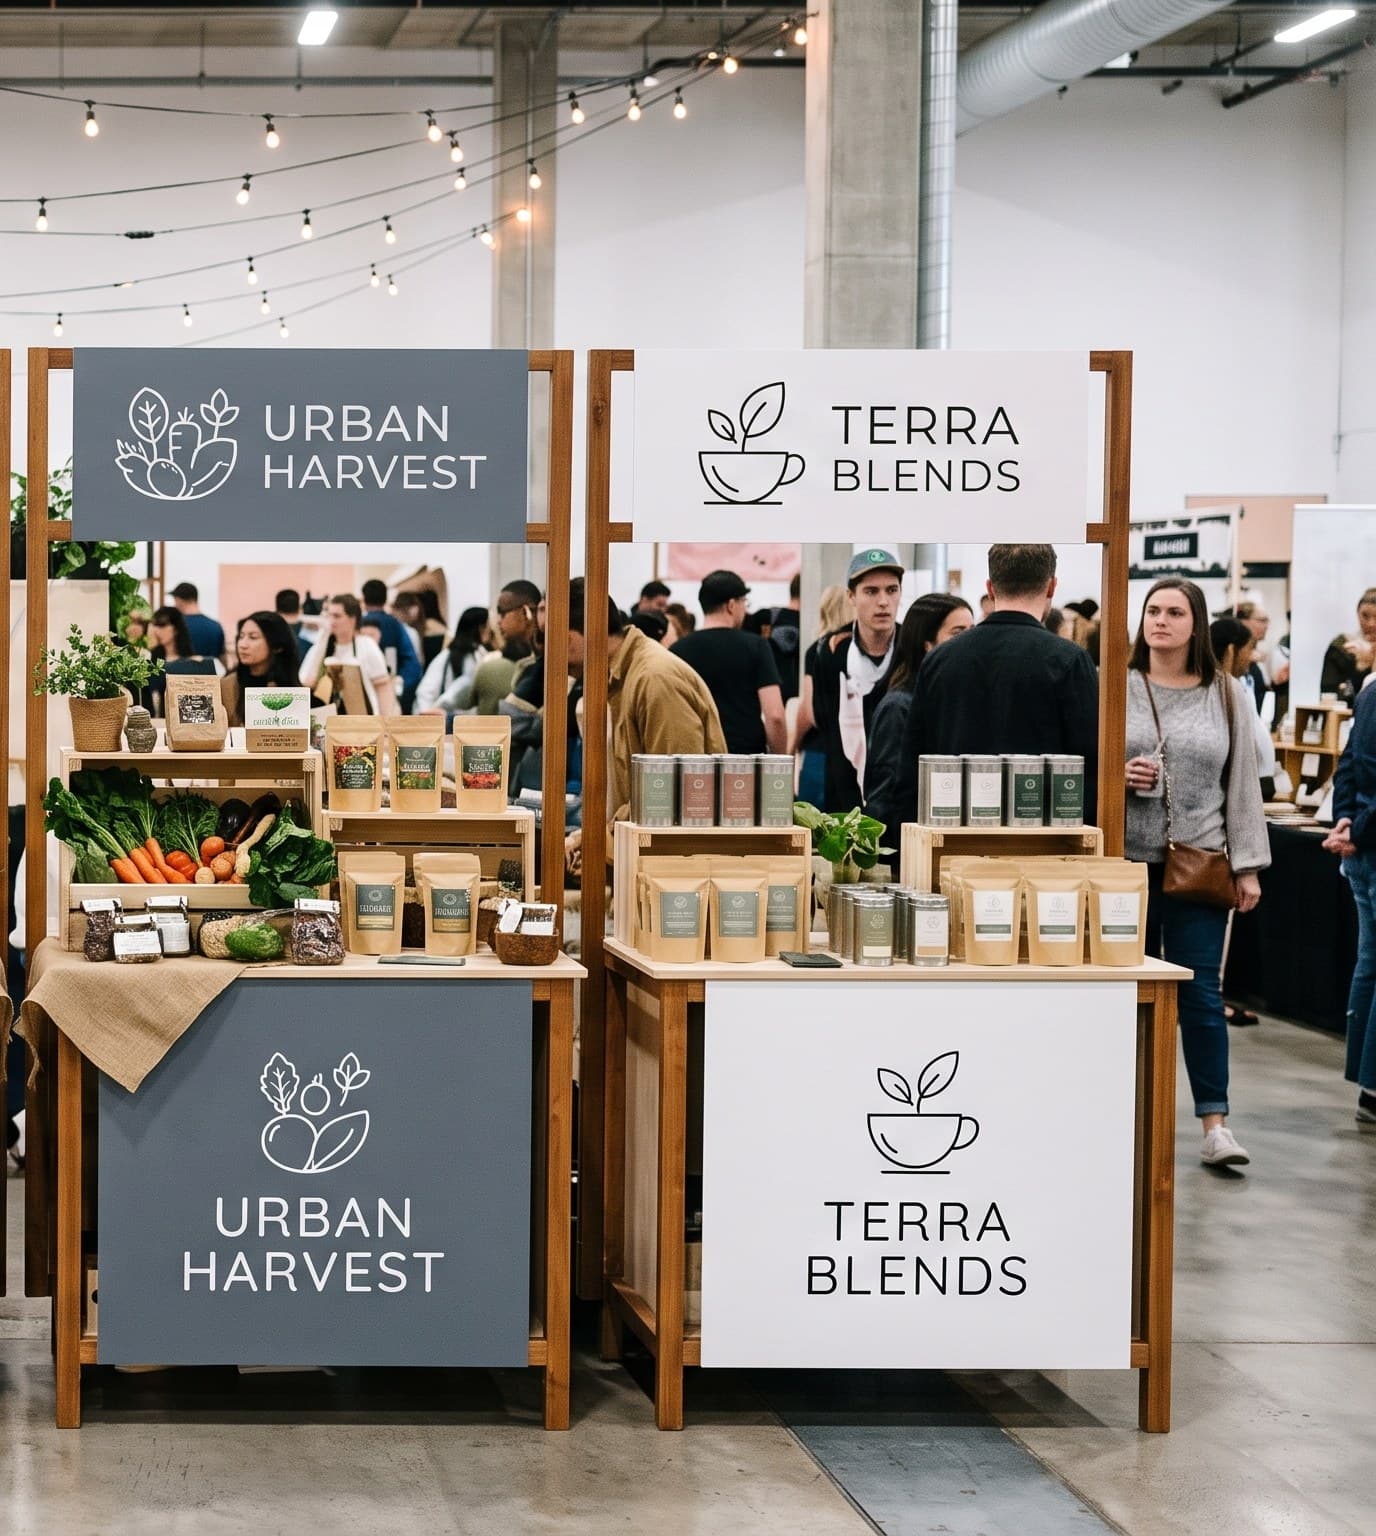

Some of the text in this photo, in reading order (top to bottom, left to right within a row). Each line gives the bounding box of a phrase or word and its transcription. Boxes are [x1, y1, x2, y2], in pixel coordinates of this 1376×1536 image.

[265, 404, 449, 442] URBAN
[831, 405, 1020, 445] TERRA
[264, 454, 487, 490] HARVEST
[833, 459, 1021, 493] BLENDS
[216, 1196, 411, 1238] URBAN
[823, 1201, 1011, 1242] TERRA
[183, 1251, 445, 1293] HARVEST
[807, 1255, 1027, 1297] BLENDS
